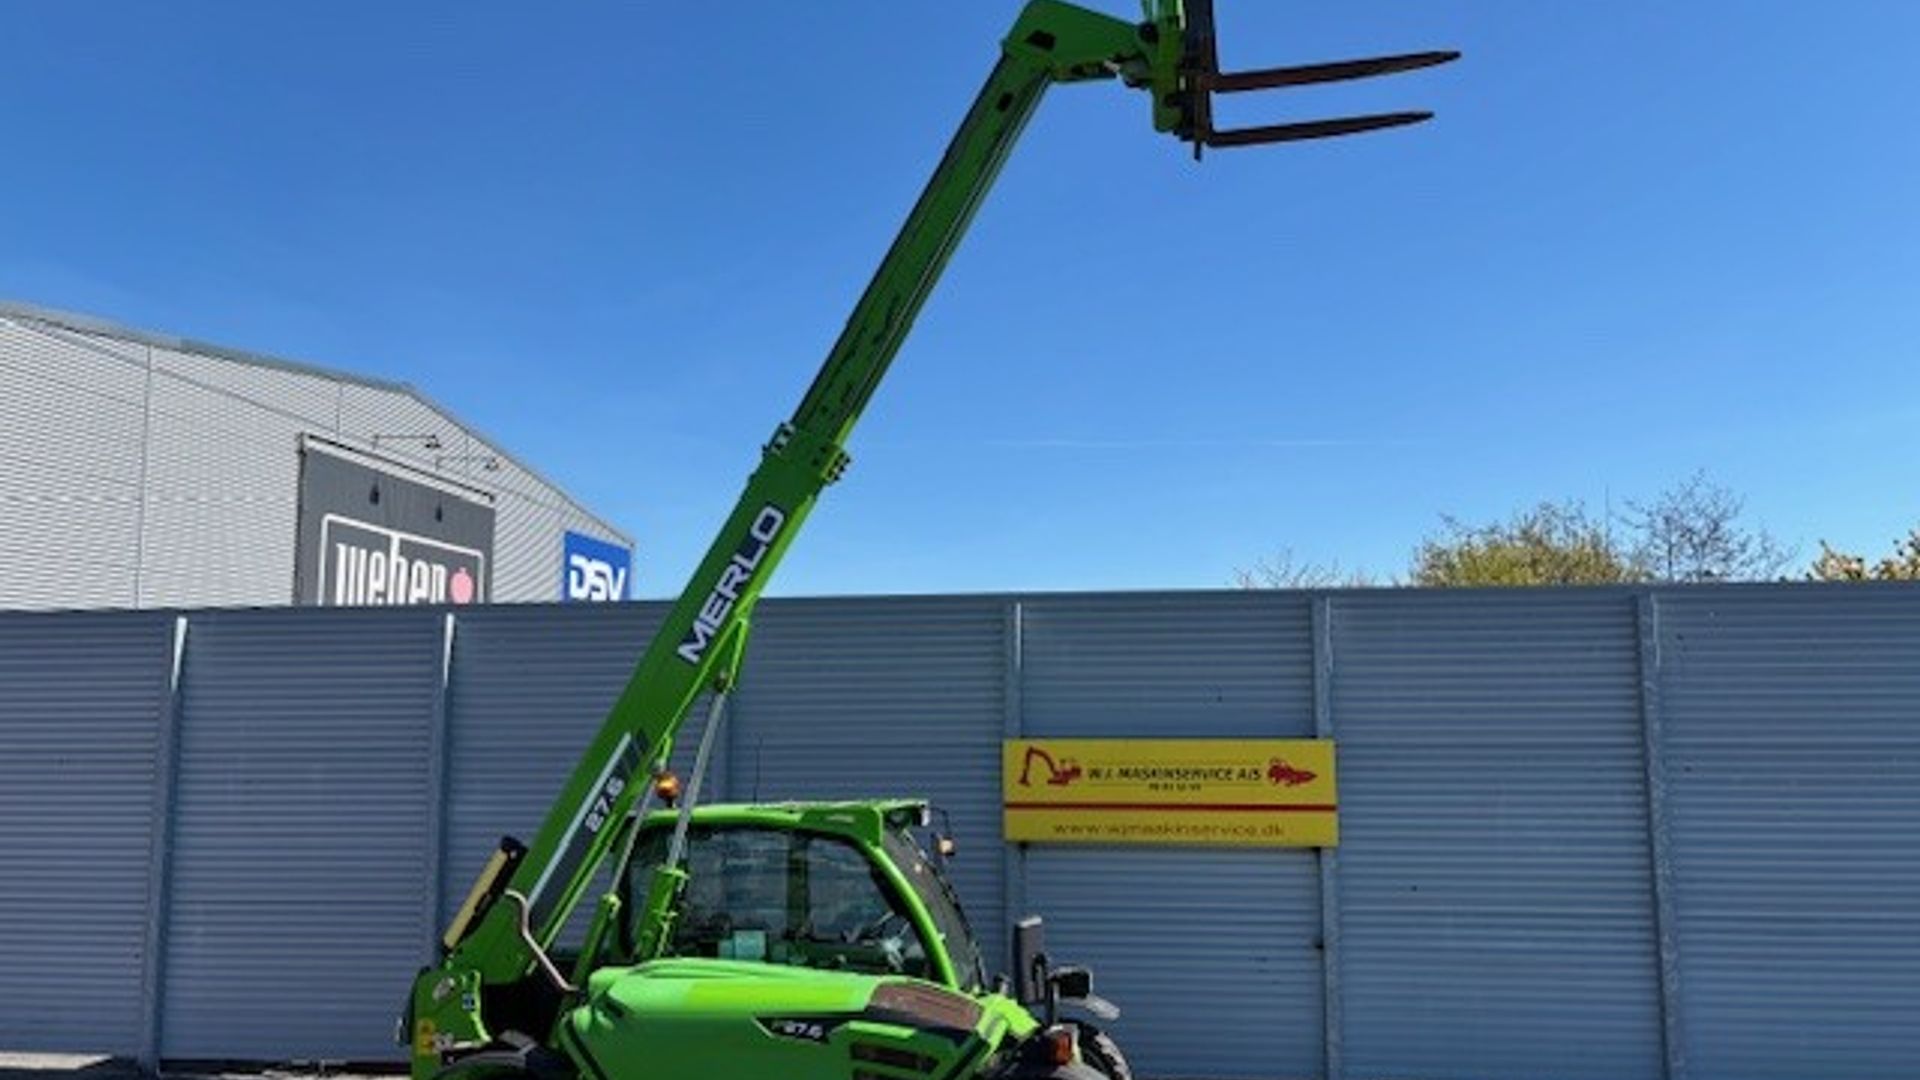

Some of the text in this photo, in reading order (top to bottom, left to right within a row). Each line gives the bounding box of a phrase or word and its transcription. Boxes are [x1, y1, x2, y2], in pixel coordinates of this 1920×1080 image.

[569, 553, 626, 602] DSV
[677, 505, 785, 663] MERLO
[1117, 766, 1232, 782] MASKINSERVICE
